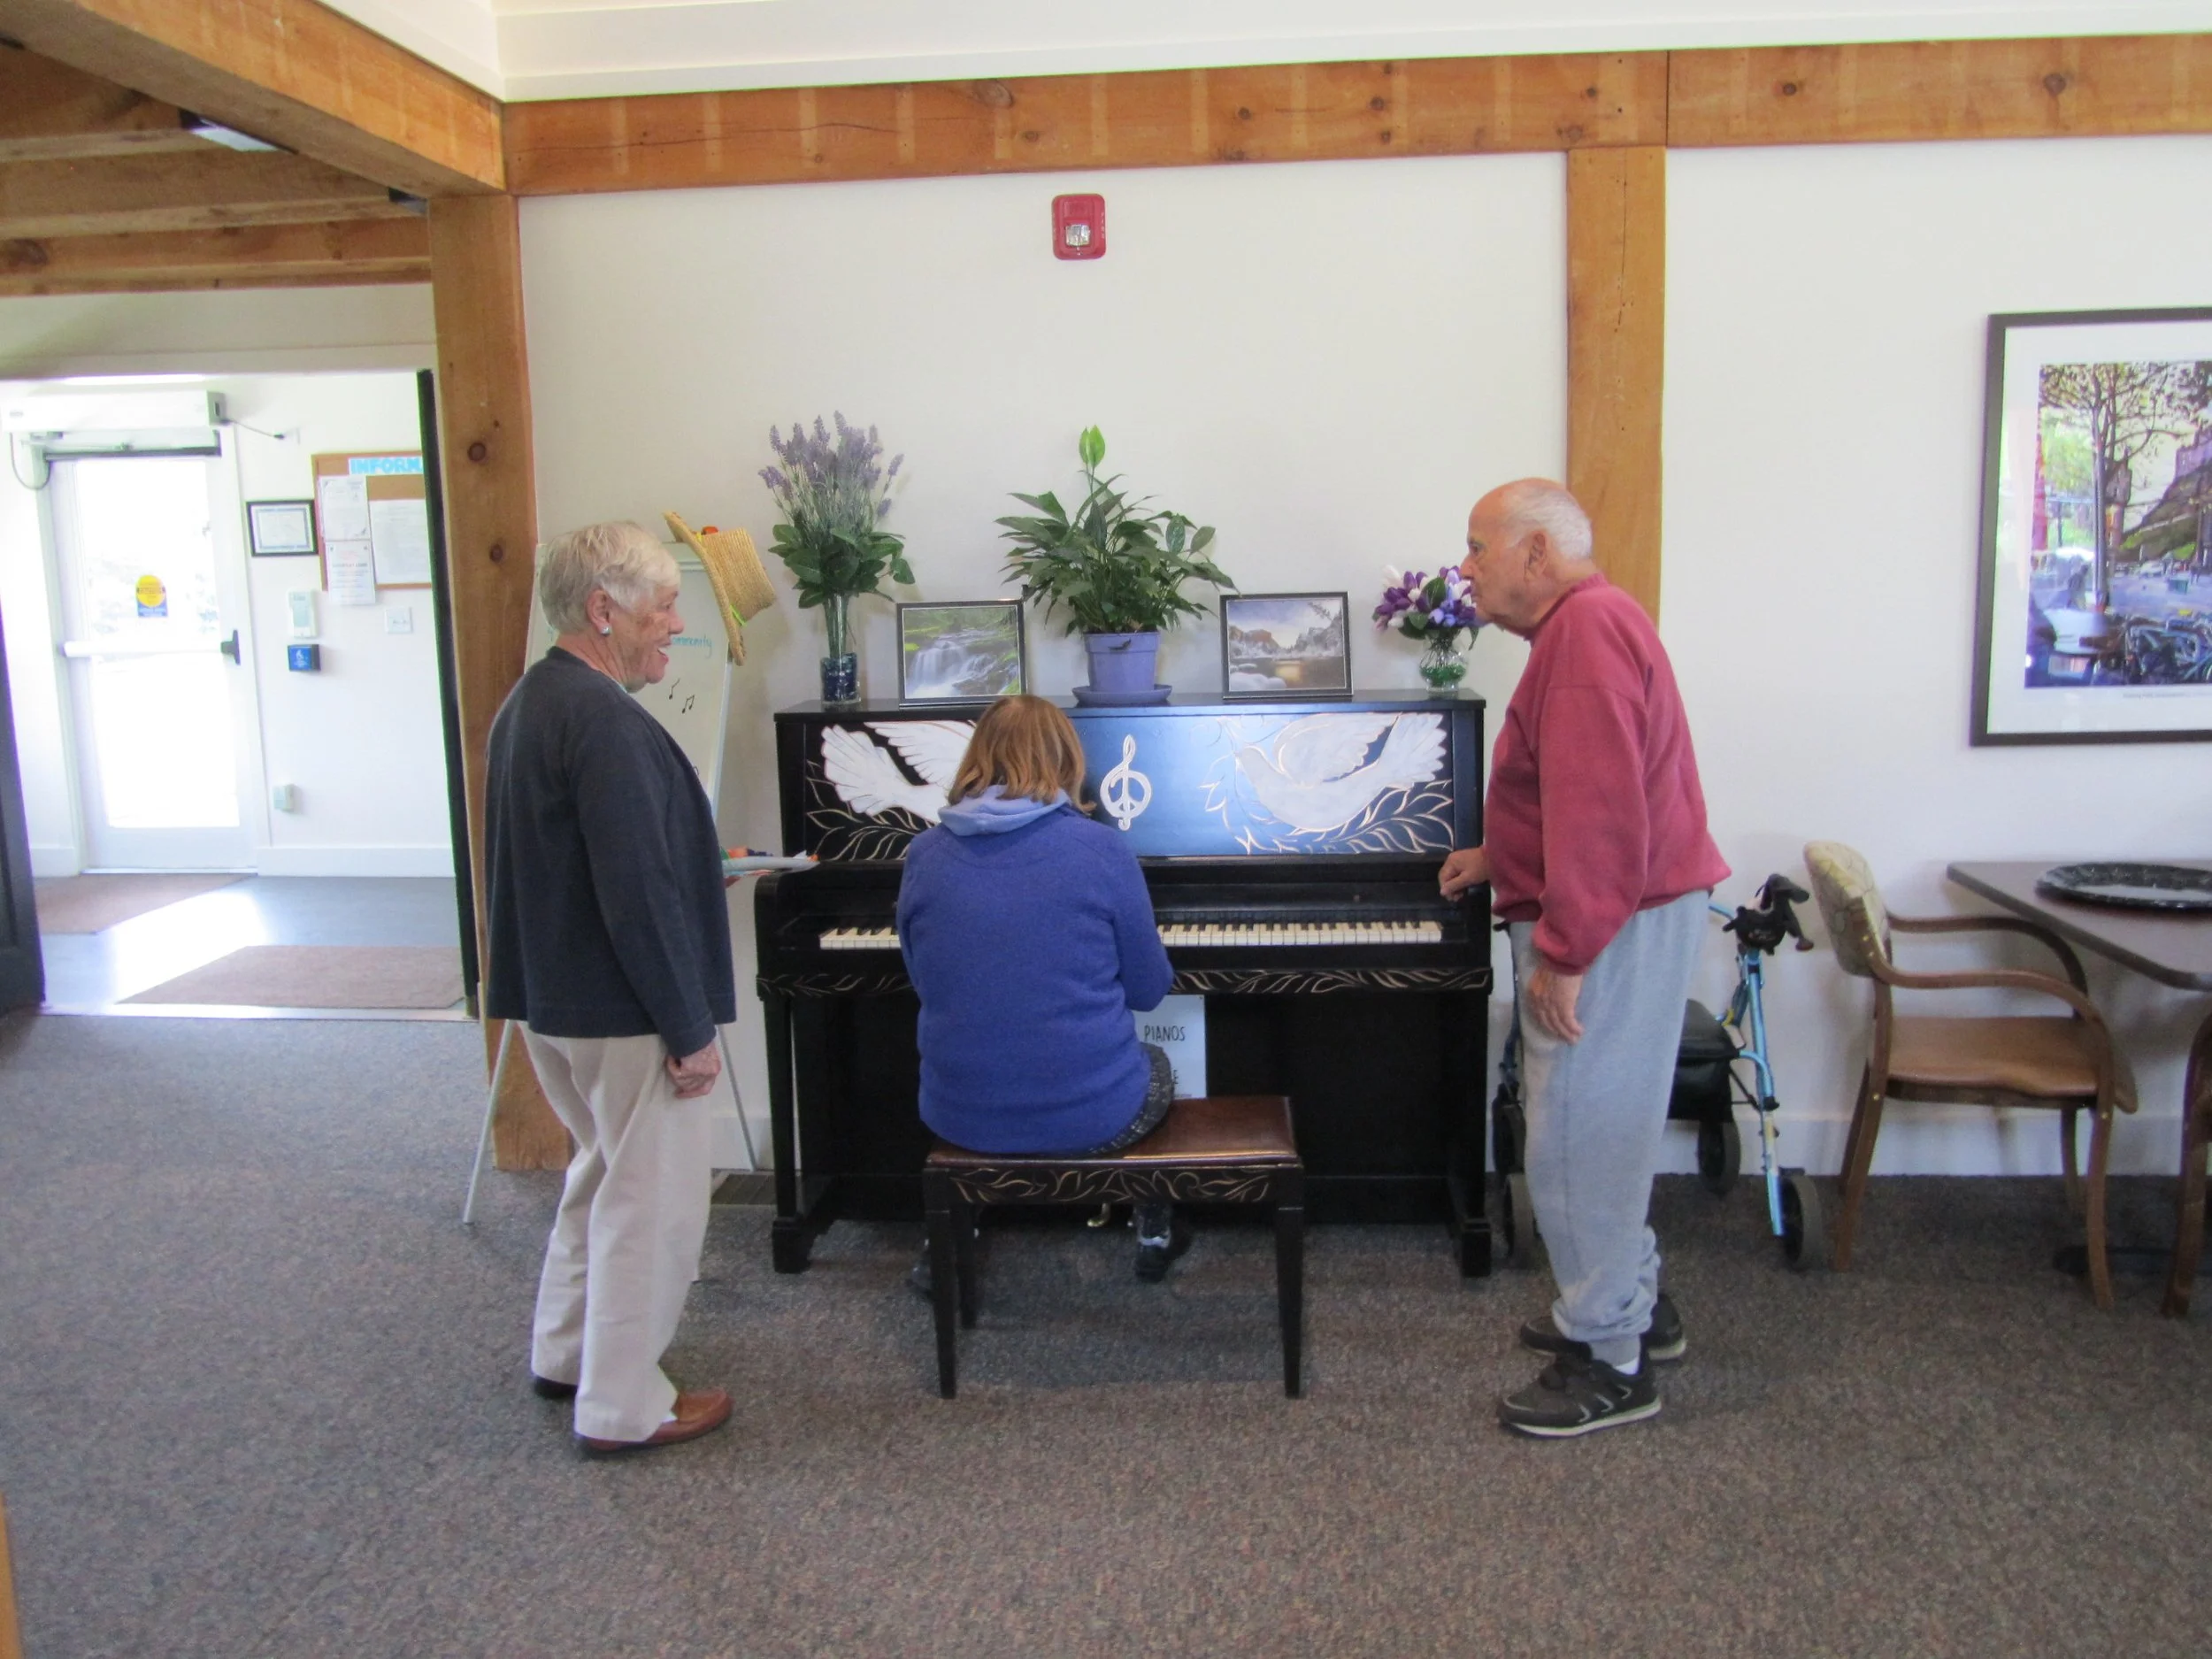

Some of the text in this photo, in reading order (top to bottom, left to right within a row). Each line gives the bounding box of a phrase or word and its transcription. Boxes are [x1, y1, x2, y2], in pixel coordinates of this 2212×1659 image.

[350, 457, 423, 474] INFORM
[672, 634, 713, 659] ommunity
[1144, 1025, 1186, 1041] PIANOS
